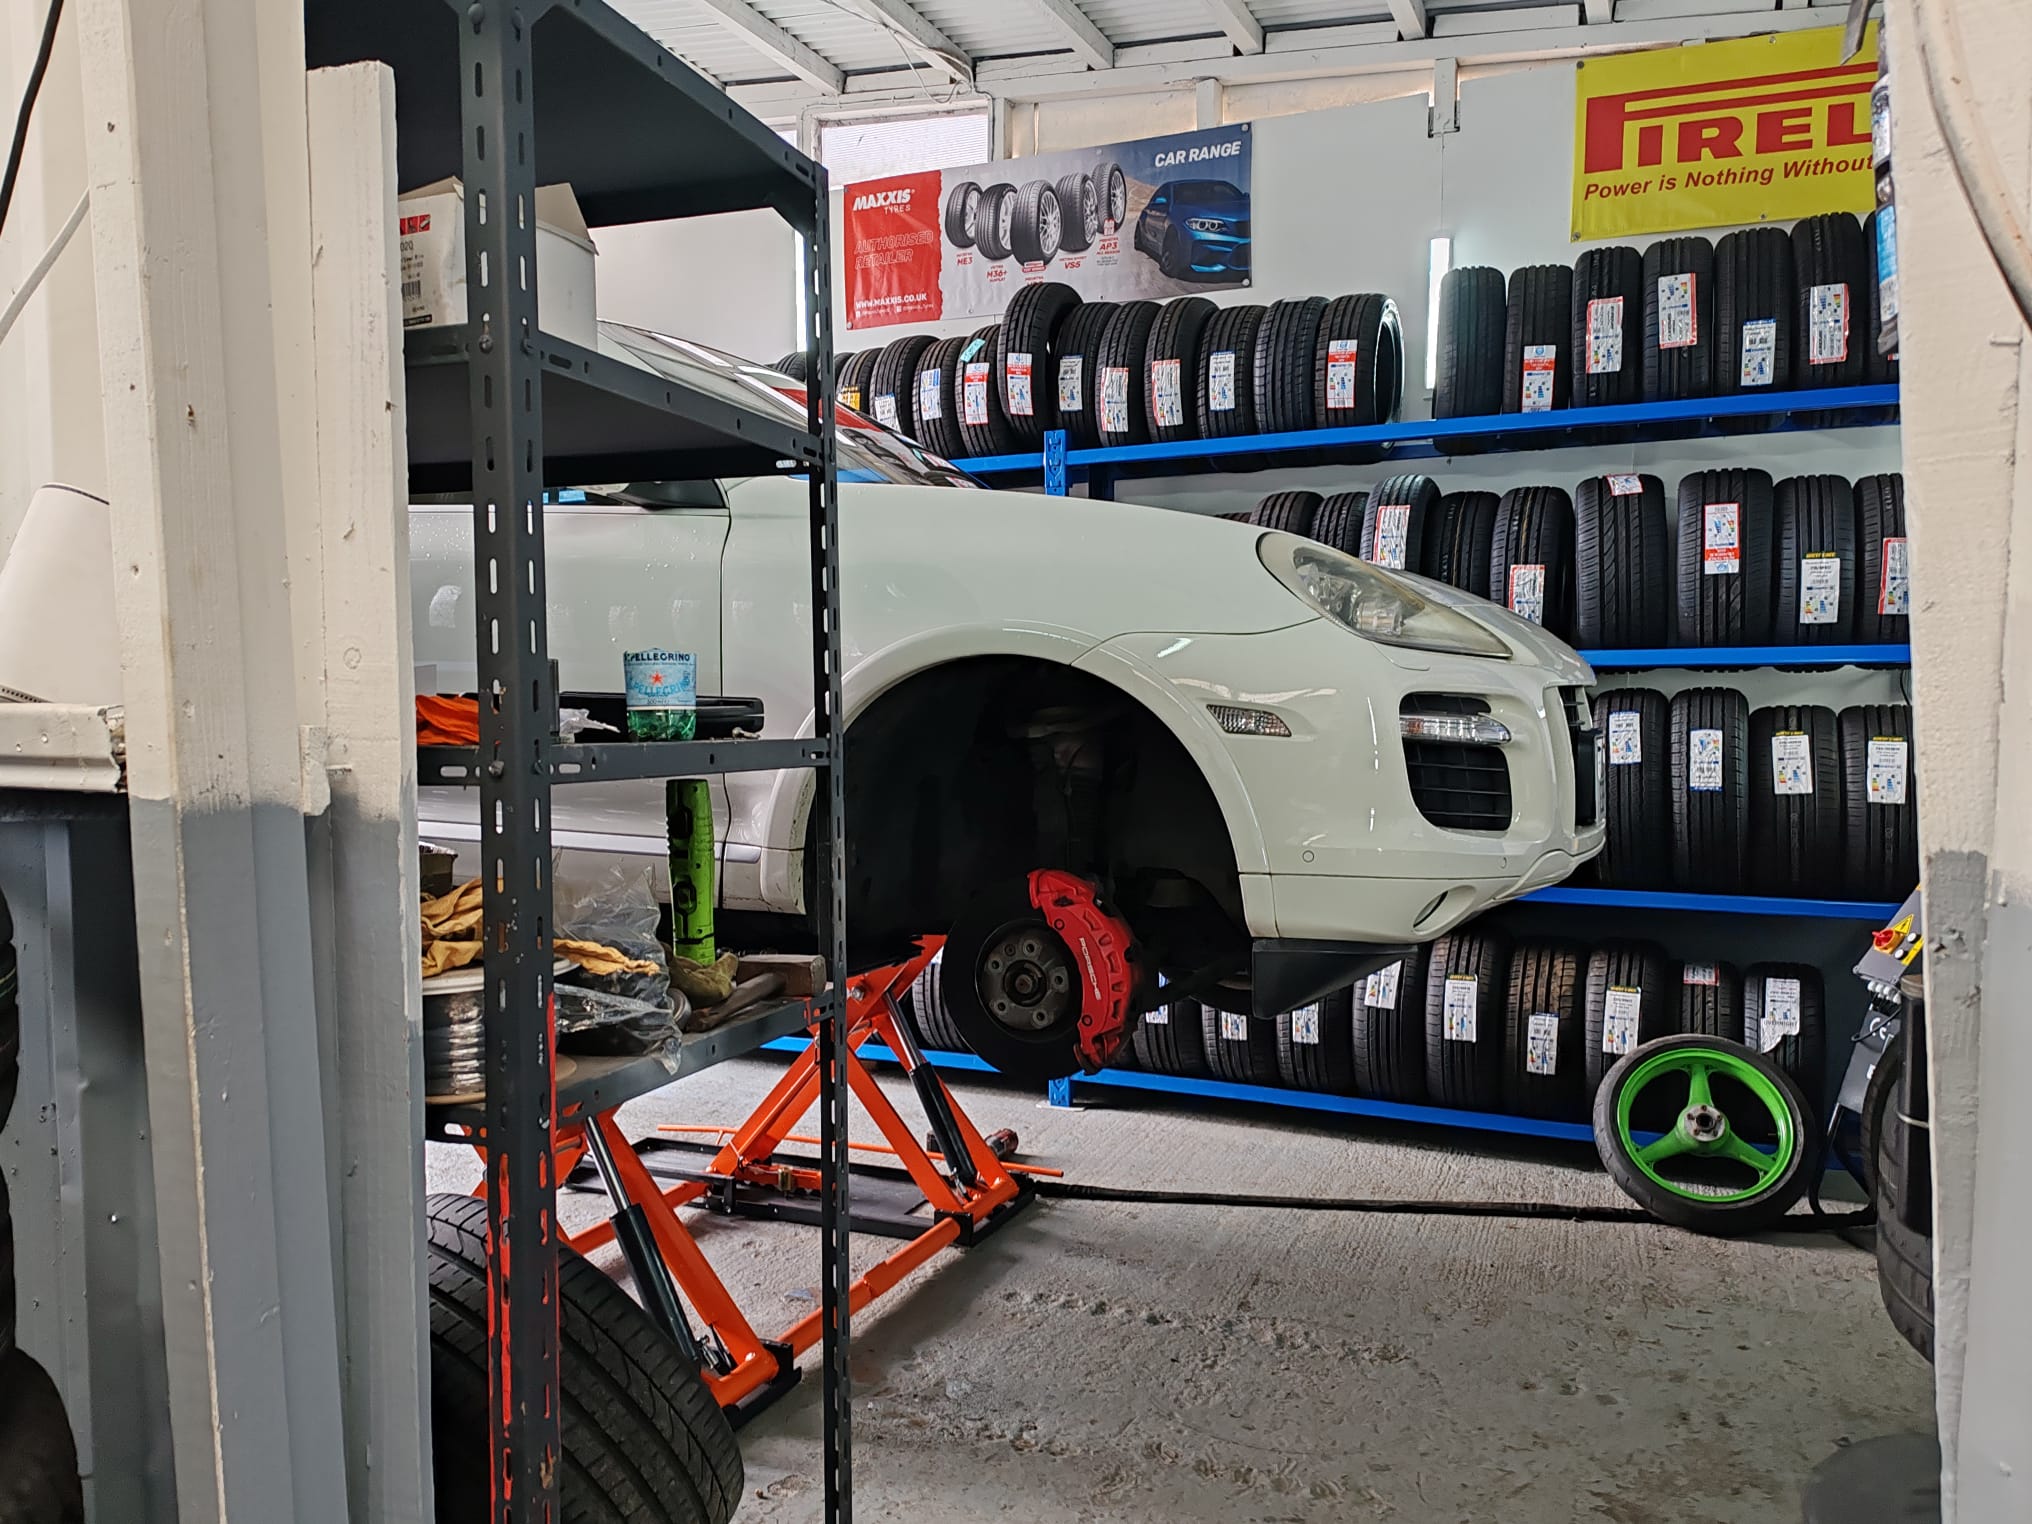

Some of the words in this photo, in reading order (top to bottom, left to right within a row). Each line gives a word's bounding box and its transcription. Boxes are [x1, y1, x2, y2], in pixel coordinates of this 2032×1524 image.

[1154, 150, 1187, 168] CAR
[1188, 141, 1242, 162] RANGE
[1584, 178, 1653, 201] Power
[1658, 174, 1677, 191] is
[1685, 166, 1774, 189] Nothing
[1783, 156, 1873, 179] Without
[852, 189, 912, 212] MAXXIS
[884, 204, 911, 215] TYRES
[854, 230, 934, 255] AUTHORISED
[1099, 242, 1118, 251] AP3
[855, 249, 913, 270] RETAILER
[1064, 261, 1081, 270] VS5
[855, 293, 927, 310] WWW.MAXXIS.CO.UK
[1079, 937, 1102, 1001] PORSCHE
